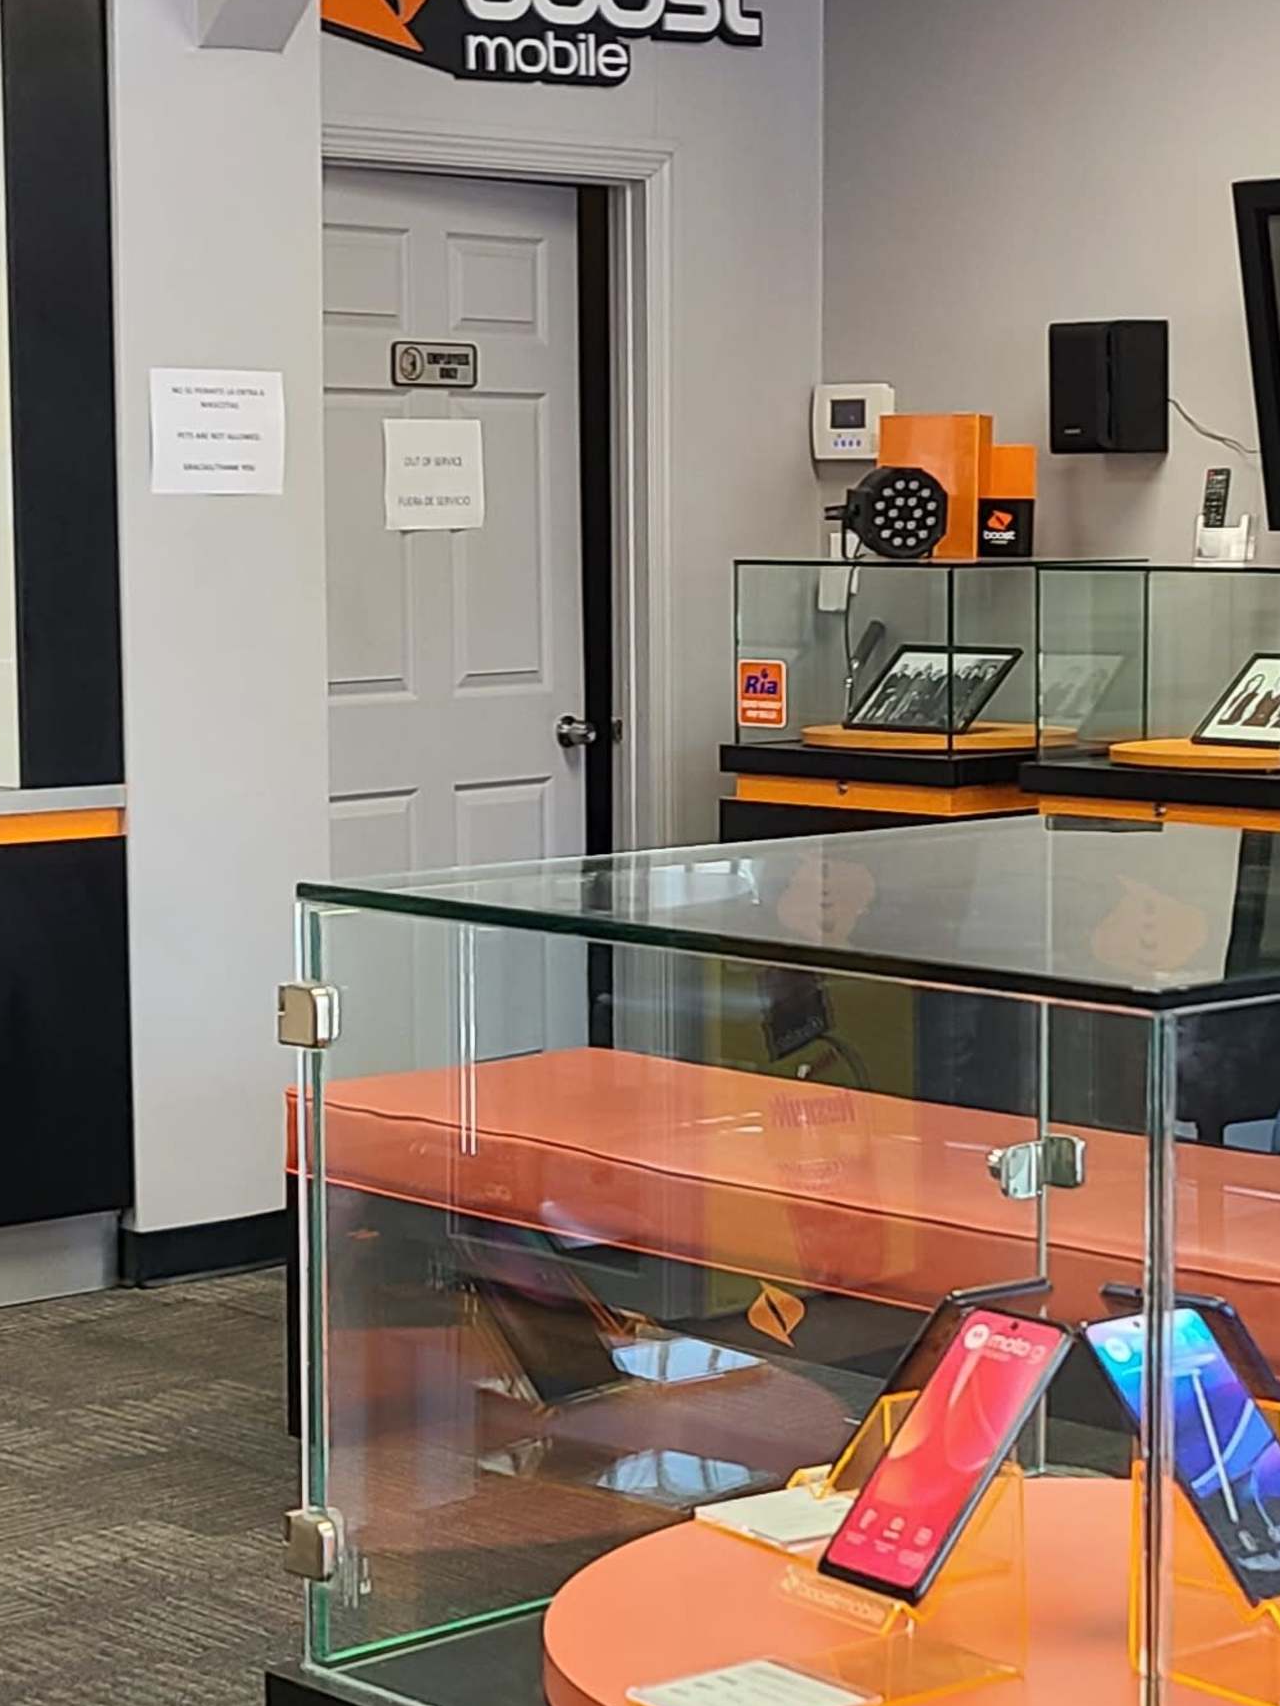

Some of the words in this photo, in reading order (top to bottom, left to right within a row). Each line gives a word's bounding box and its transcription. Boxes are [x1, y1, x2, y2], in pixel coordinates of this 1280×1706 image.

[465, 30, 629, 79] mobile
[403, 455, 420, 468] OUT
[433, 455, 463, 468] SERVICE
[743, 668, 779, 695] Ria
[989, 1333, 1031, 1358] moto
